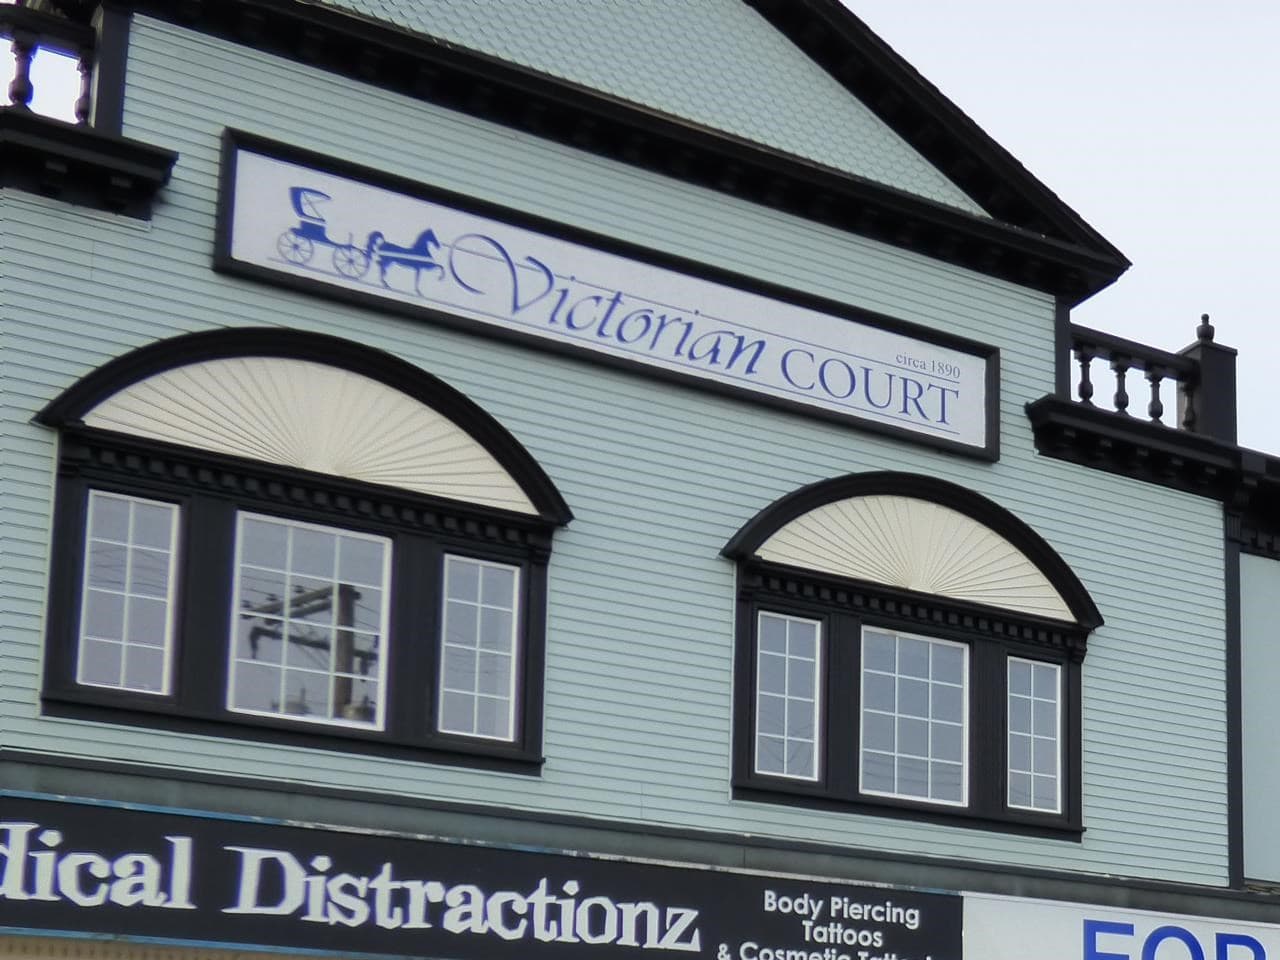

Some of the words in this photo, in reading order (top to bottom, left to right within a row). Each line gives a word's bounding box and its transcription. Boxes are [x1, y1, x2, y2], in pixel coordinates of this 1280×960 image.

[449, 233, 767, 375] Victorian
[780, 348, 960, 425] COURT
[895, 352, 927, 370] circa
[931, 360, 961, 379] 1890
[220, 845, 702, 952] Distractionz
[764, 889, 823, 920] Body
[830, 895, 920, 929] Piercing
[802, 920, 884, 948] Tattoos
